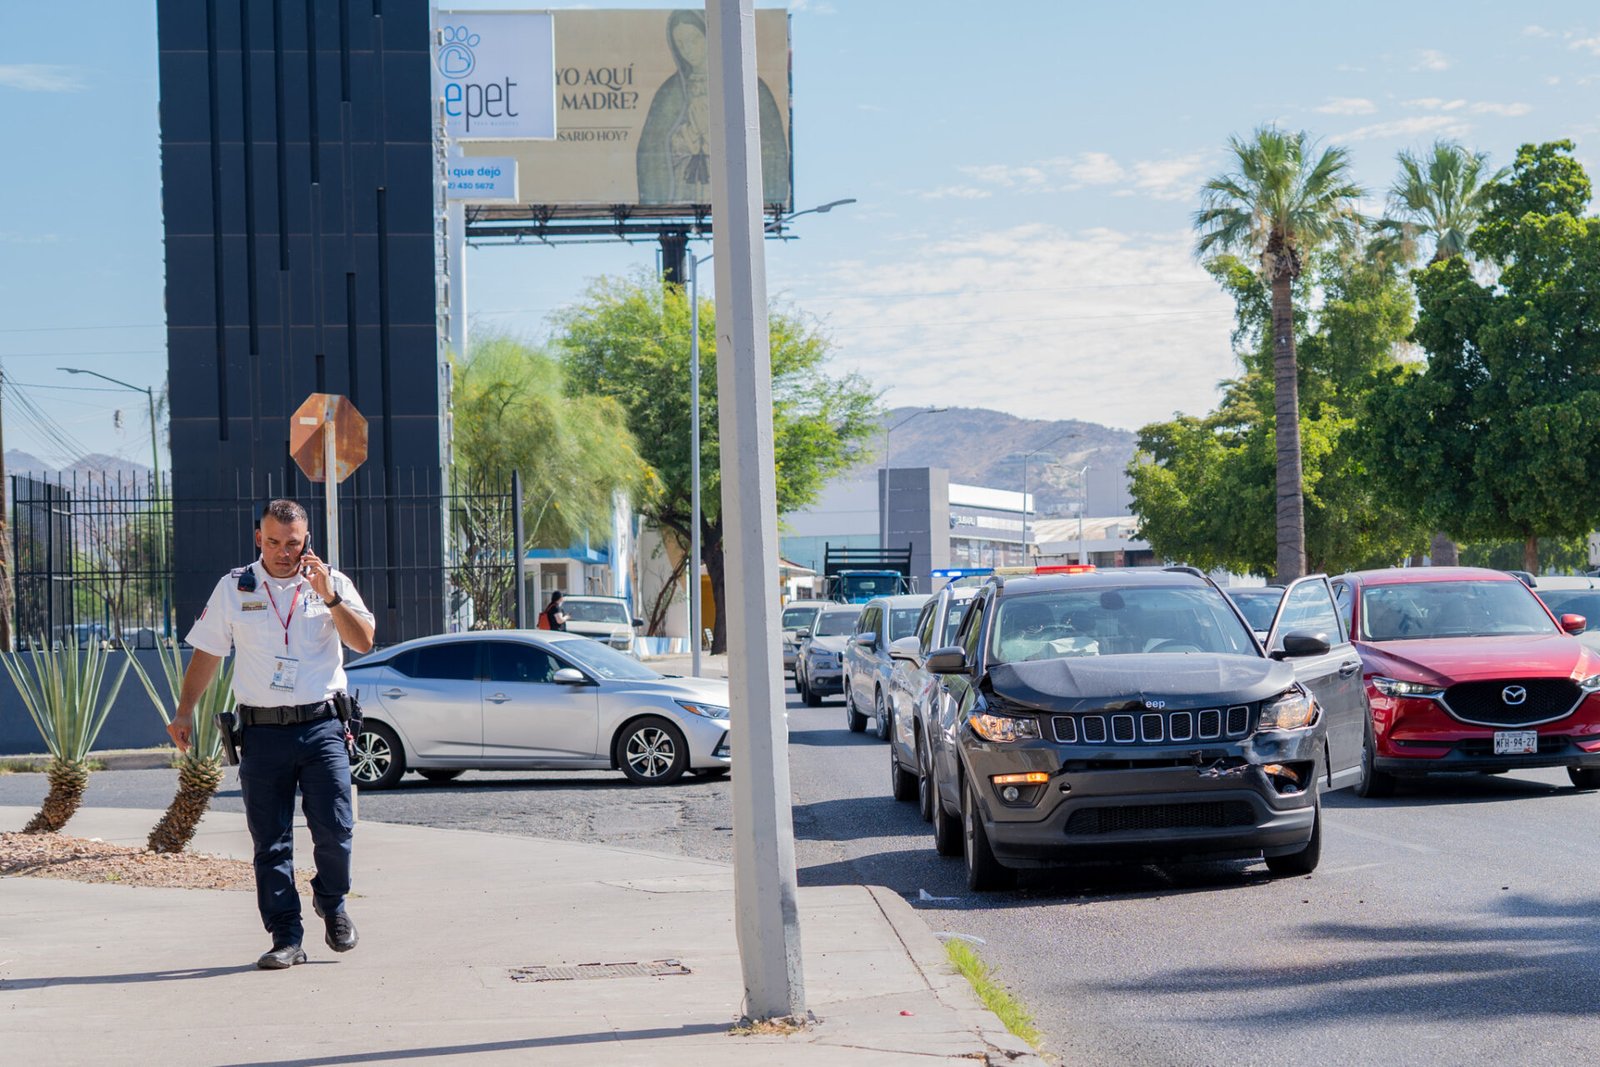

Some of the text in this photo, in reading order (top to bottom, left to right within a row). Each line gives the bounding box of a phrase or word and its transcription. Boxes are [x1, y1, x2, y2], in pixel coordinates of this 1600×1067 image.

[584, 62, 634, 91] AQUÍ
[561, 91, 639, 110] MADRE?
[597, 130, 628, 141] HOY?
[453, 168, 474, 178] que
[457, 182, 473, 190] 430
[1145, 700, 1165, 709] eep
